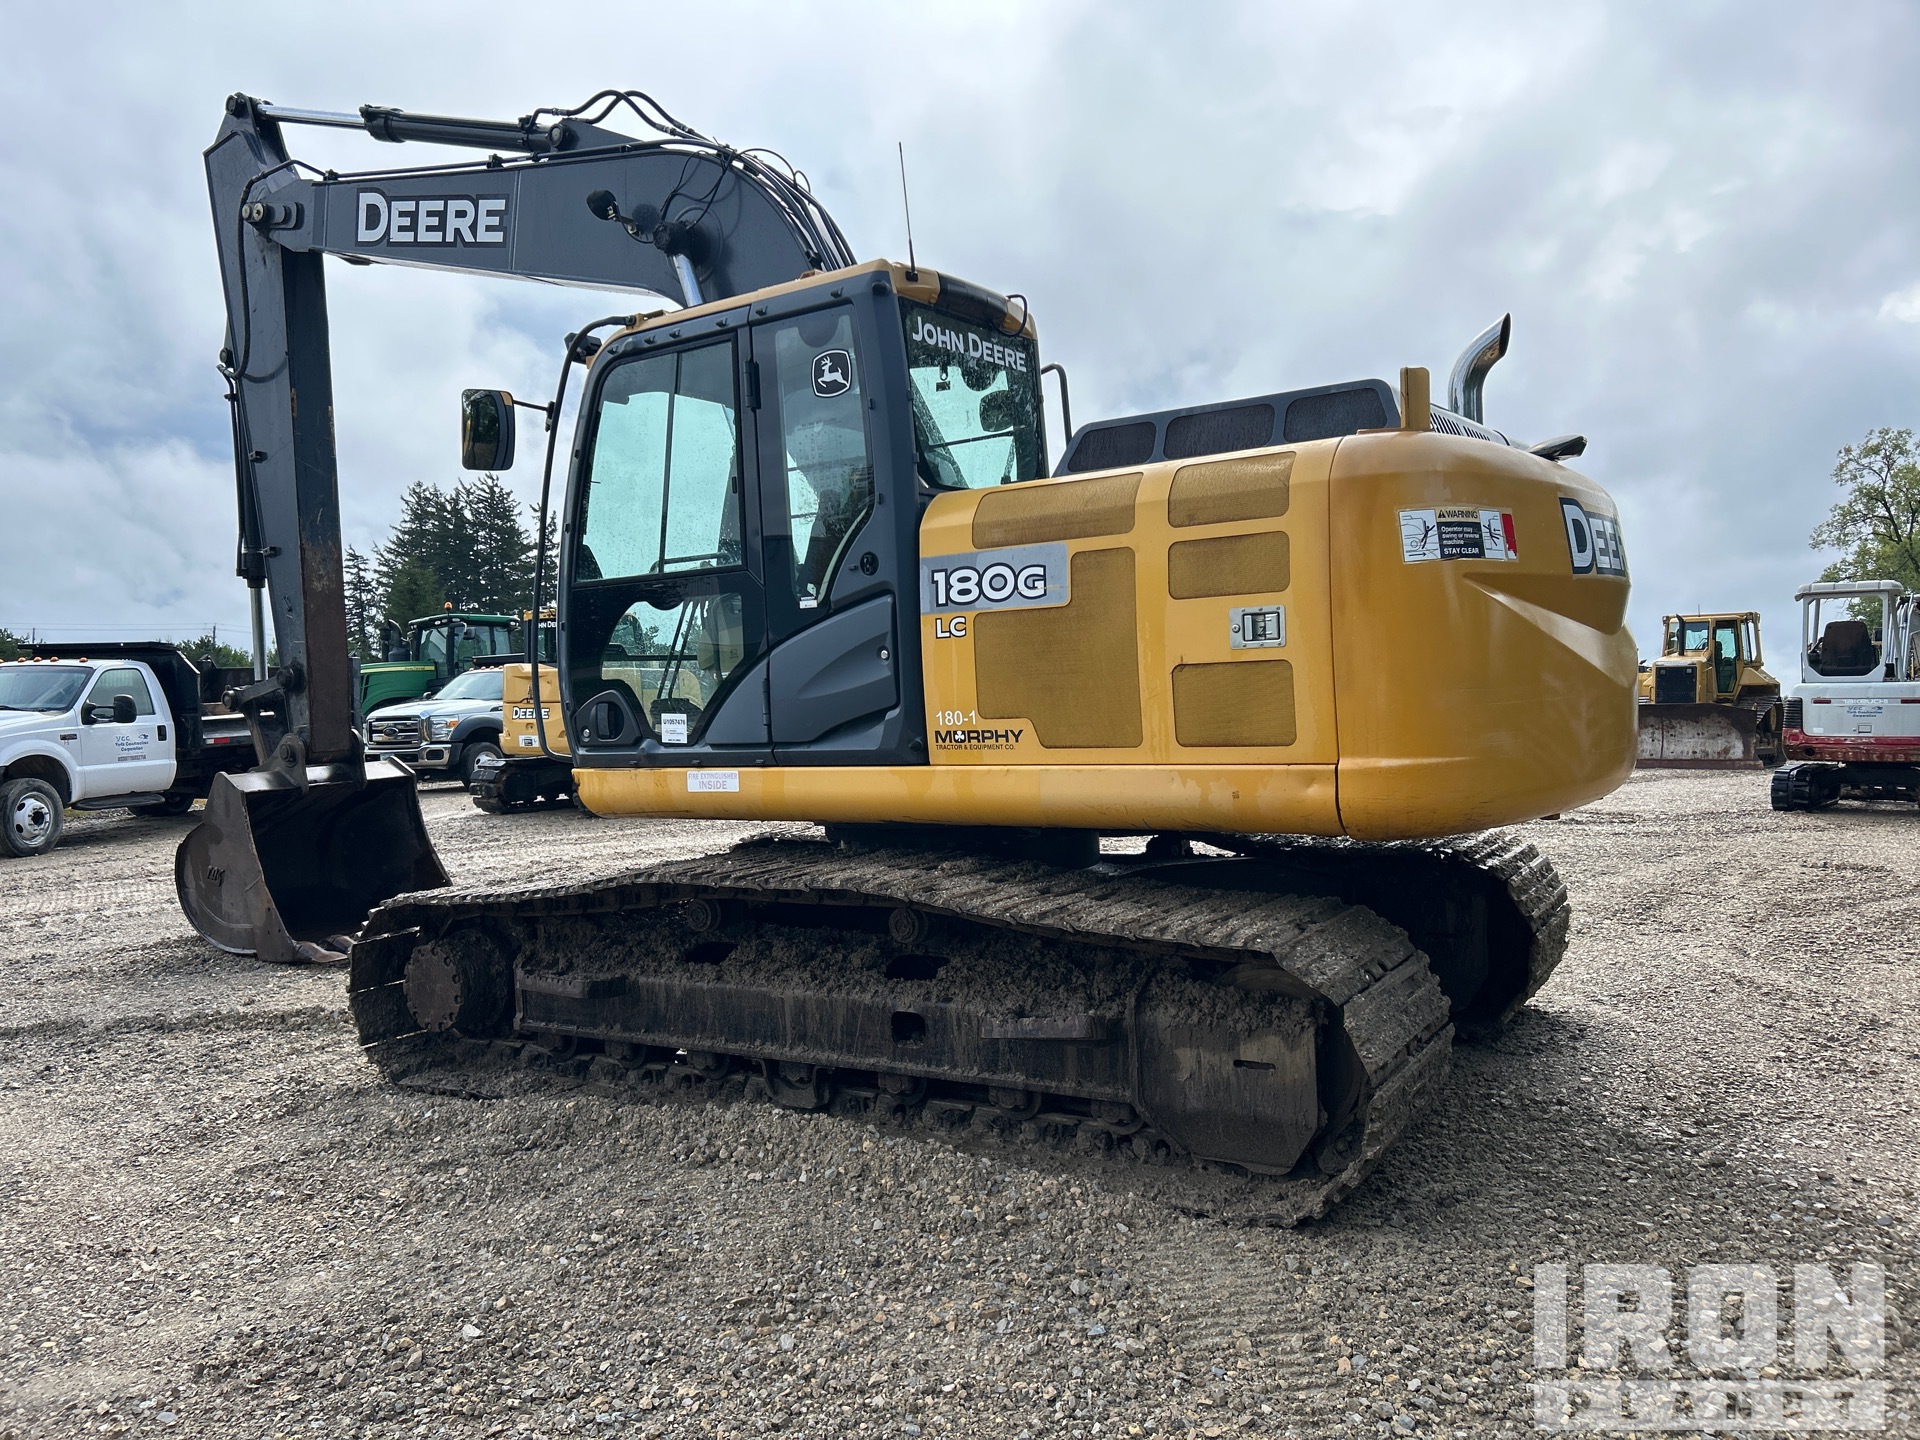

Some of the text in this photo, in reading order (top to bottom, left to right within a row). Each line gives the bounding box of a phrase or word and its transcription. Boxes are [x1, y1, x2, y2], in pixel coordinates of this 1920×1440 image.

[357, 192, 506, 243] DEERE
[912, 316, 1027, 373] JOHN DEERE
[1445, 510, 1478, 519] WARNING
[1562, 504, 1625, 571] DEER
[1443, 547, 1460, 555] STAY
[932, 562, 1047, 607] 180G
[935, 616, 966, 639] LC
[512, 706, 549, 719] DEEE
[935, 710, 976, 726] 180-1
[934, 729, 1024, 744] MURPHY
[700, 772, 738, 780] EXTINGUISHER
[699, 780, 728, 790] INSIDE
